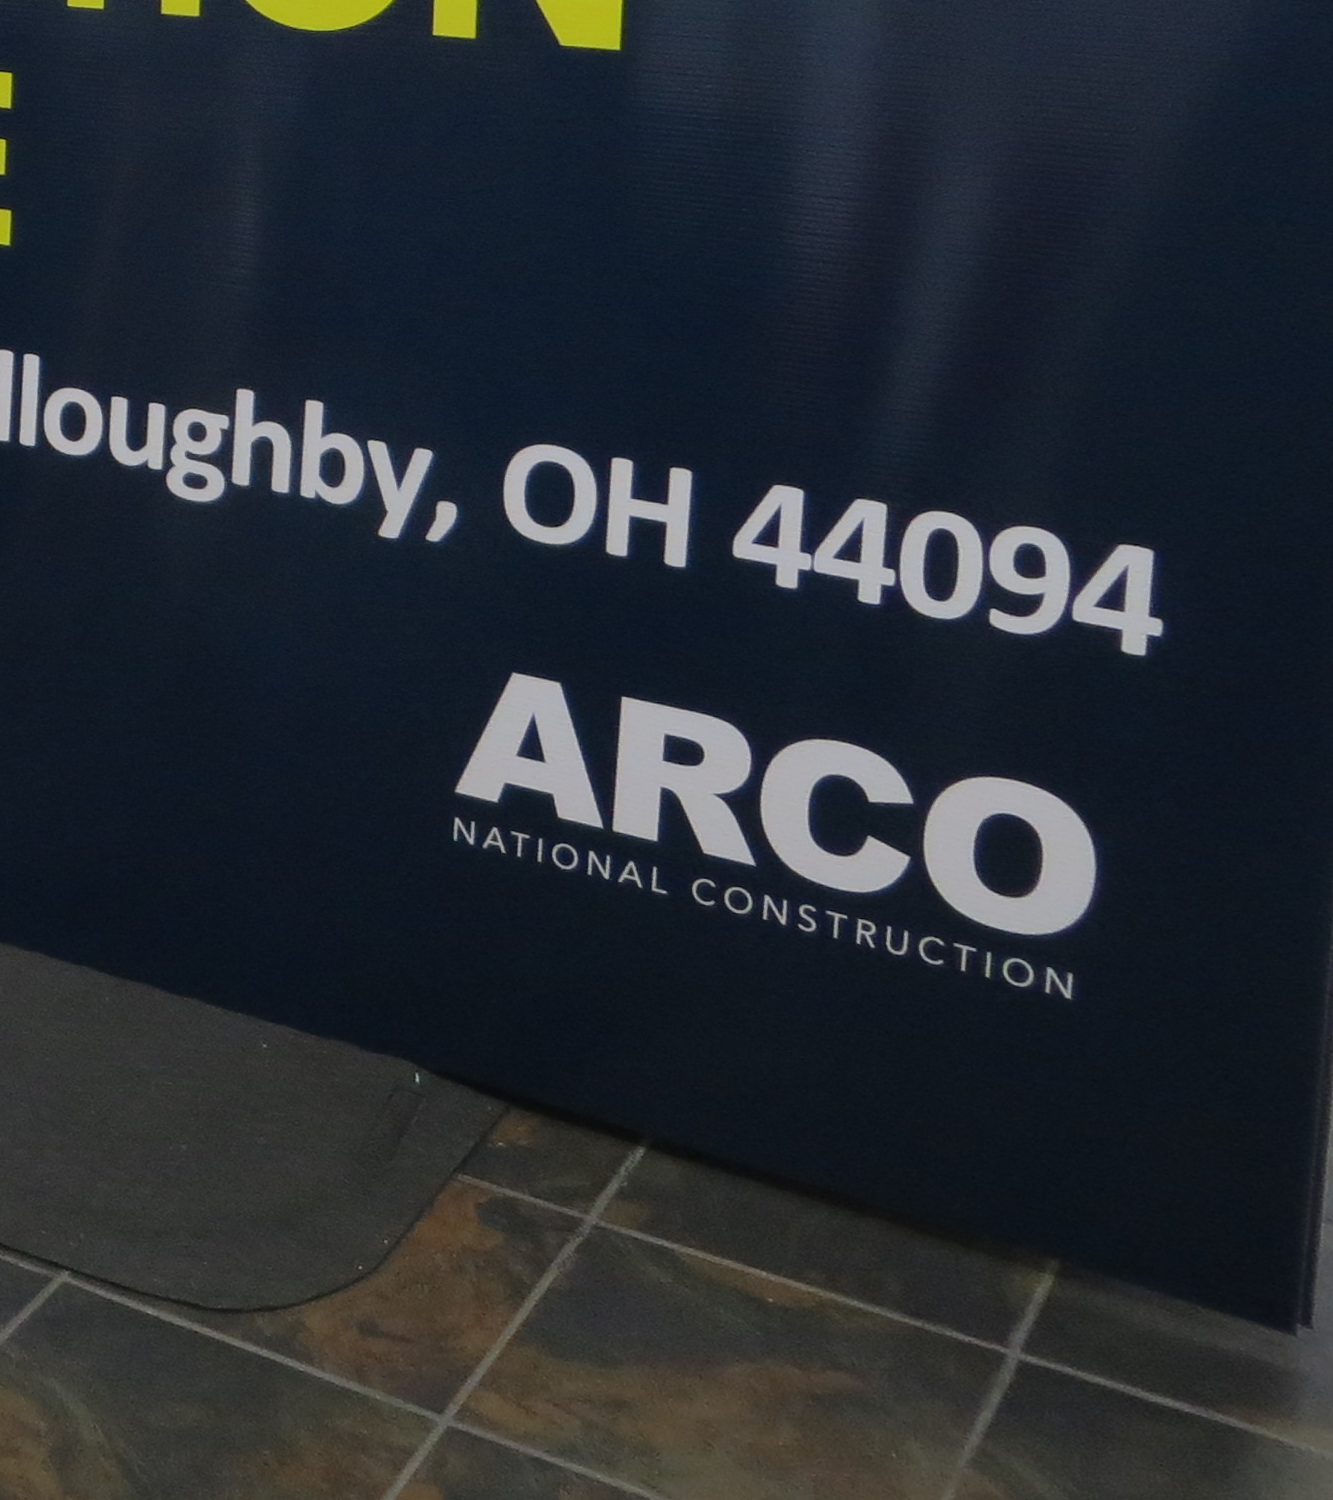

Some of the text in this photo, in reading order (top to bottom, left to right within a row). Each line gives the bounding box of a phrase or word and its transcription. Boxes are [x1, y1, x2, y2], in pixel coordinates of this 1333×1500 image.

[501, 443, 694, 569] OH
[731, 482, 1164, 657] 44094
[452, 815, 1075, 1001] NATIONAL CONSTRUCTION
[453, 671, 1097, 936] ARCO
